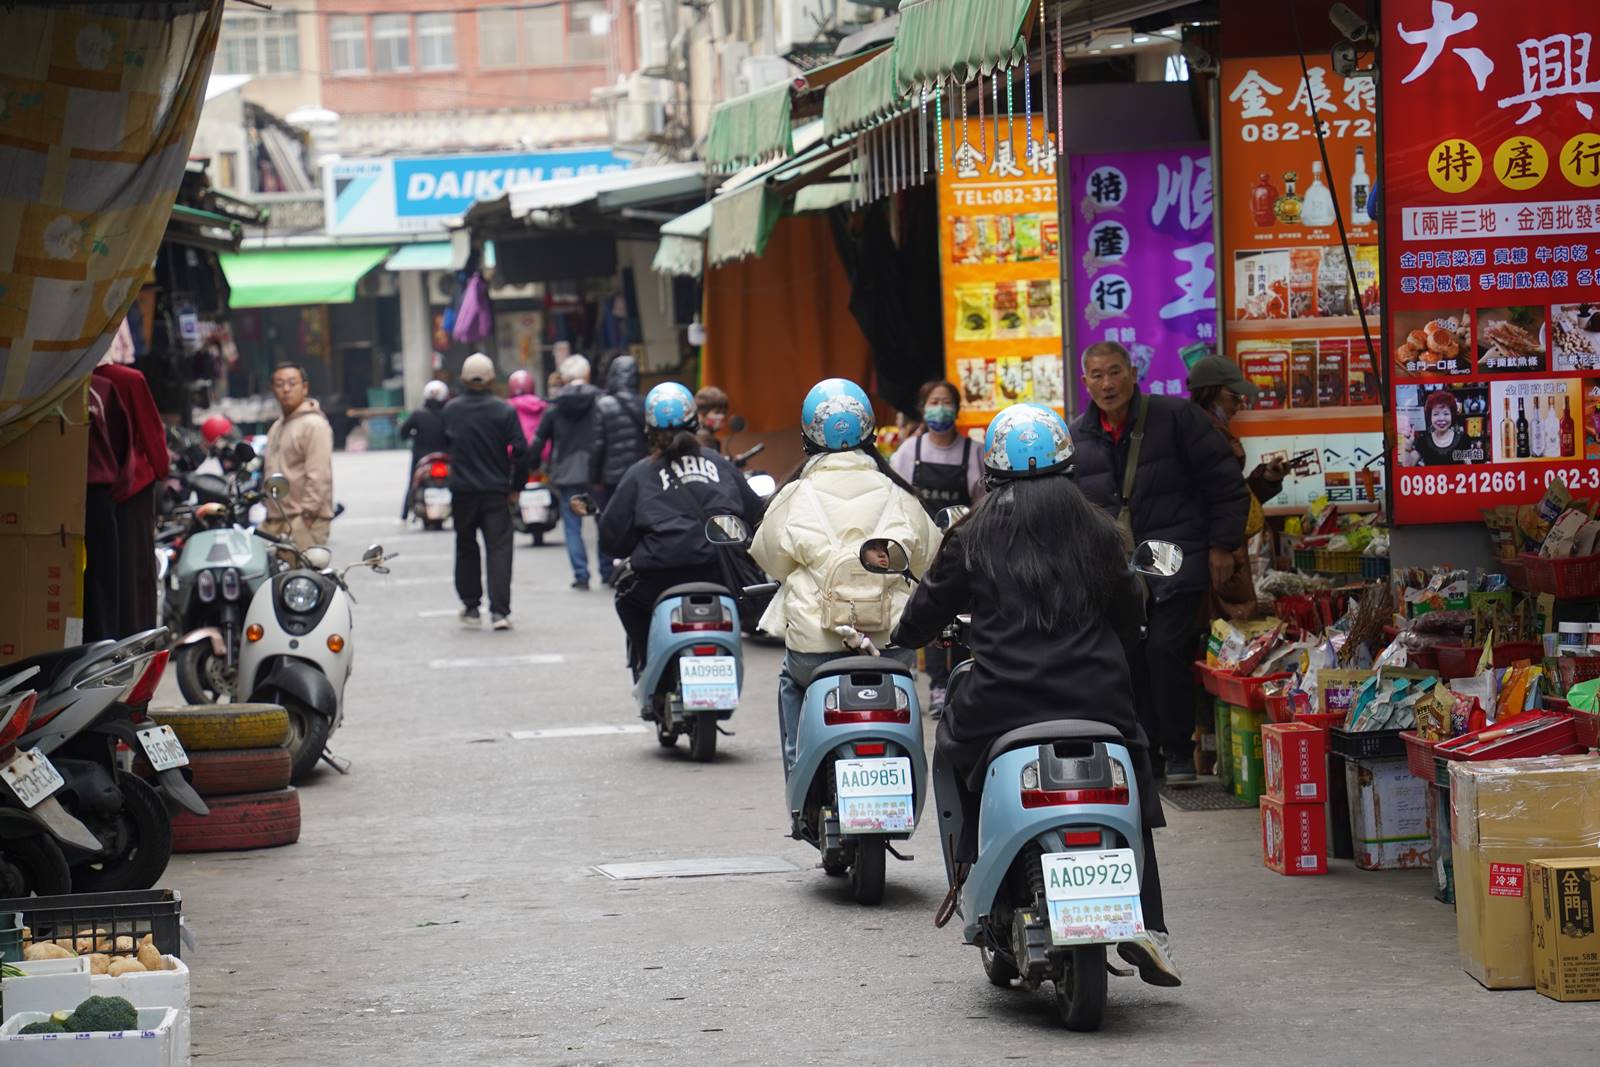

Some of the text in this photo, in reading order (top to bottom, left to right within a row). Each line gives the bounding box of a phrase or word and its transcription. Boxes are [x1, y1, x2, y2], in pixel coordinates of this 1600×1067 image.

[1397, 0, 1600, 125] 大興
[1241, 119, 1376, 142] 082-372
[1436, 142, 1600, 182] 特產行
[407, 166, 545, 201] DAIKIN
[1091, 171, 1128, 311] 特產行
[1400, 245, 1588, 269] 金門高粱酒 貢糖 牛肉乾
[1480, 270, 1568, 290] 手撕魷魚條
[1576, 269, 1600, 286] 各
[1400, 470, 1527, 497] 0988-212661
[683, 664, 734, 678] AA09883
[841, 768, 906, 788] AA09851
[1050, 863, 1132, 889] AA09929
[1495, 875, 1518, 886] 冷凍
[1562, 870, 1583, 921] 金門
